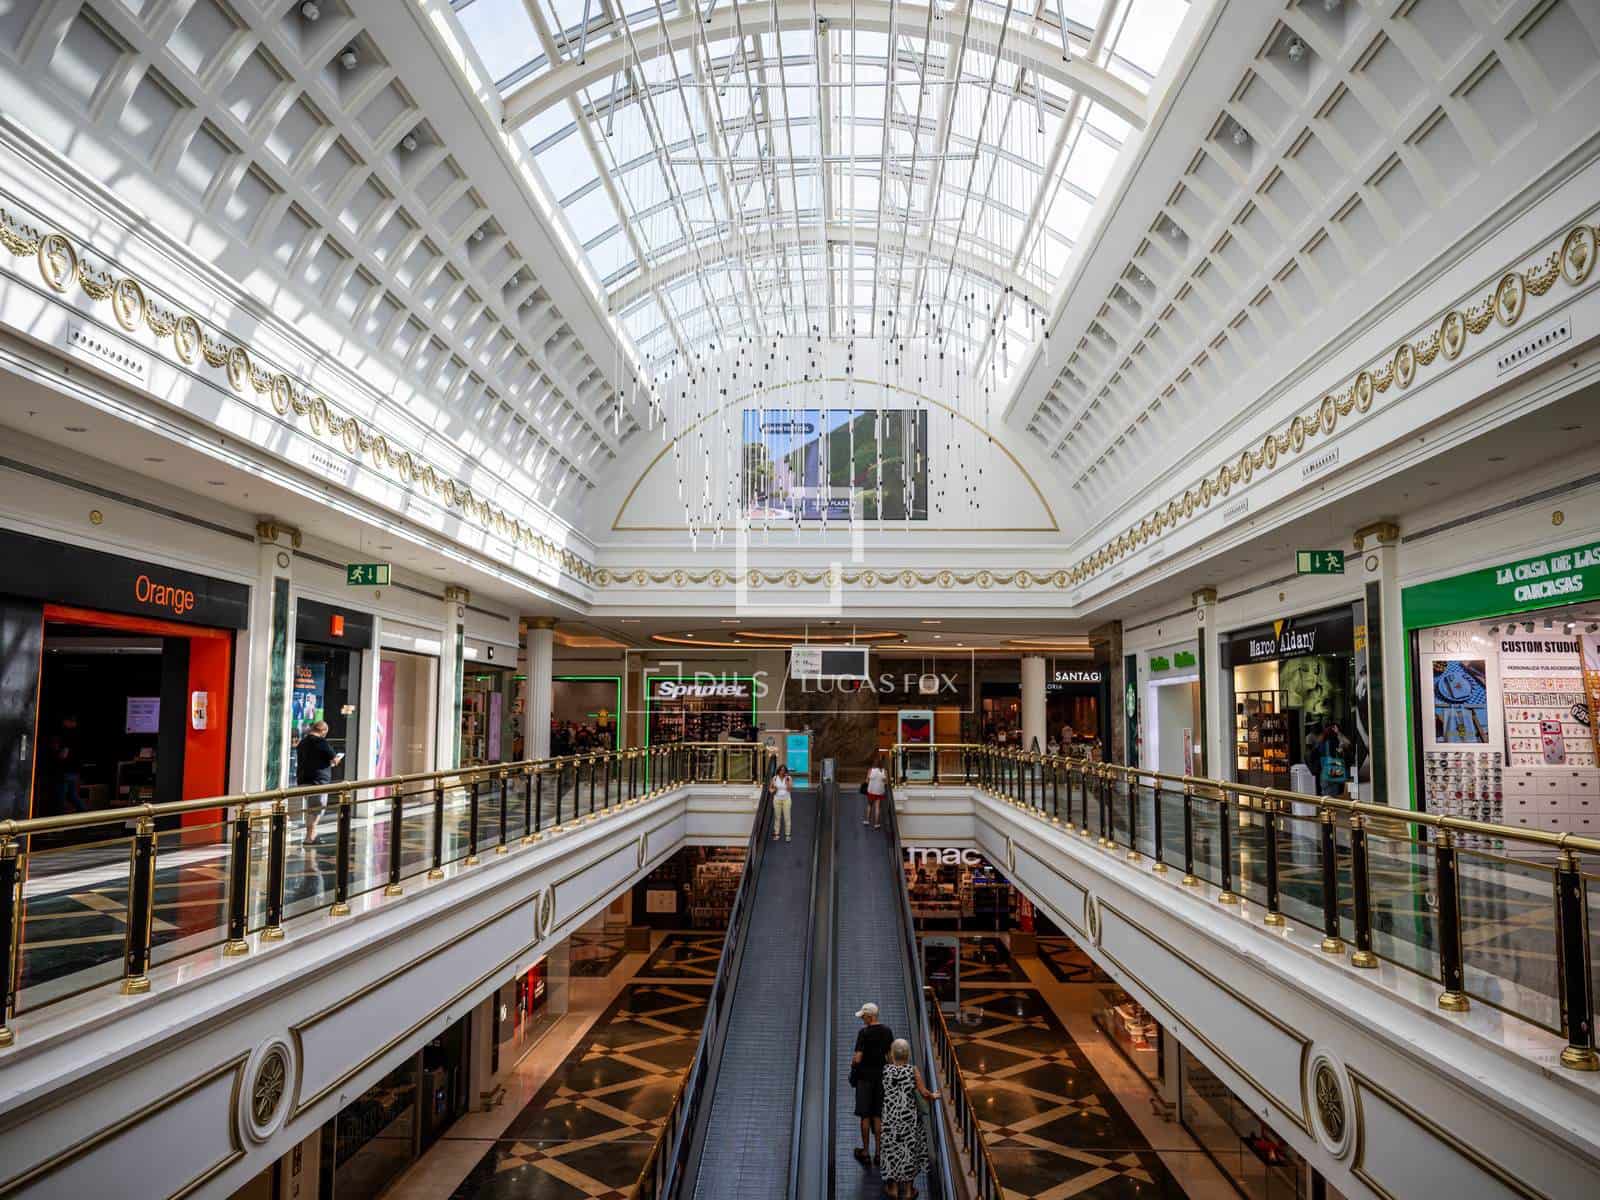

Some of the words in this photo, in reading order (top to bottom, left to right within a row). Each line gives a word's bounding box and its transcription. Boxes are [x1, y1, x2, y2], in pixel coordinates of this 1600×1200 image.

[1496, 568, 1514, 585] LA
[1515, 560, 1550, 580] CASA
[1551, 555, 1572, 574] DE
[1573, 547, 1600, 569] LAS
[135, 575, 194, 615] Orange
[1514, 574, 1583, 602] CARCASAS
[1249, 640, 1276, 657] Marco
[1279, 630, 1317, 652] Aldany
[1501, 640, 1542, 653] CUSTOM
[1544, 641, 1580, 653] STUDIO
[659, 681, 749, 698] Sprinter
